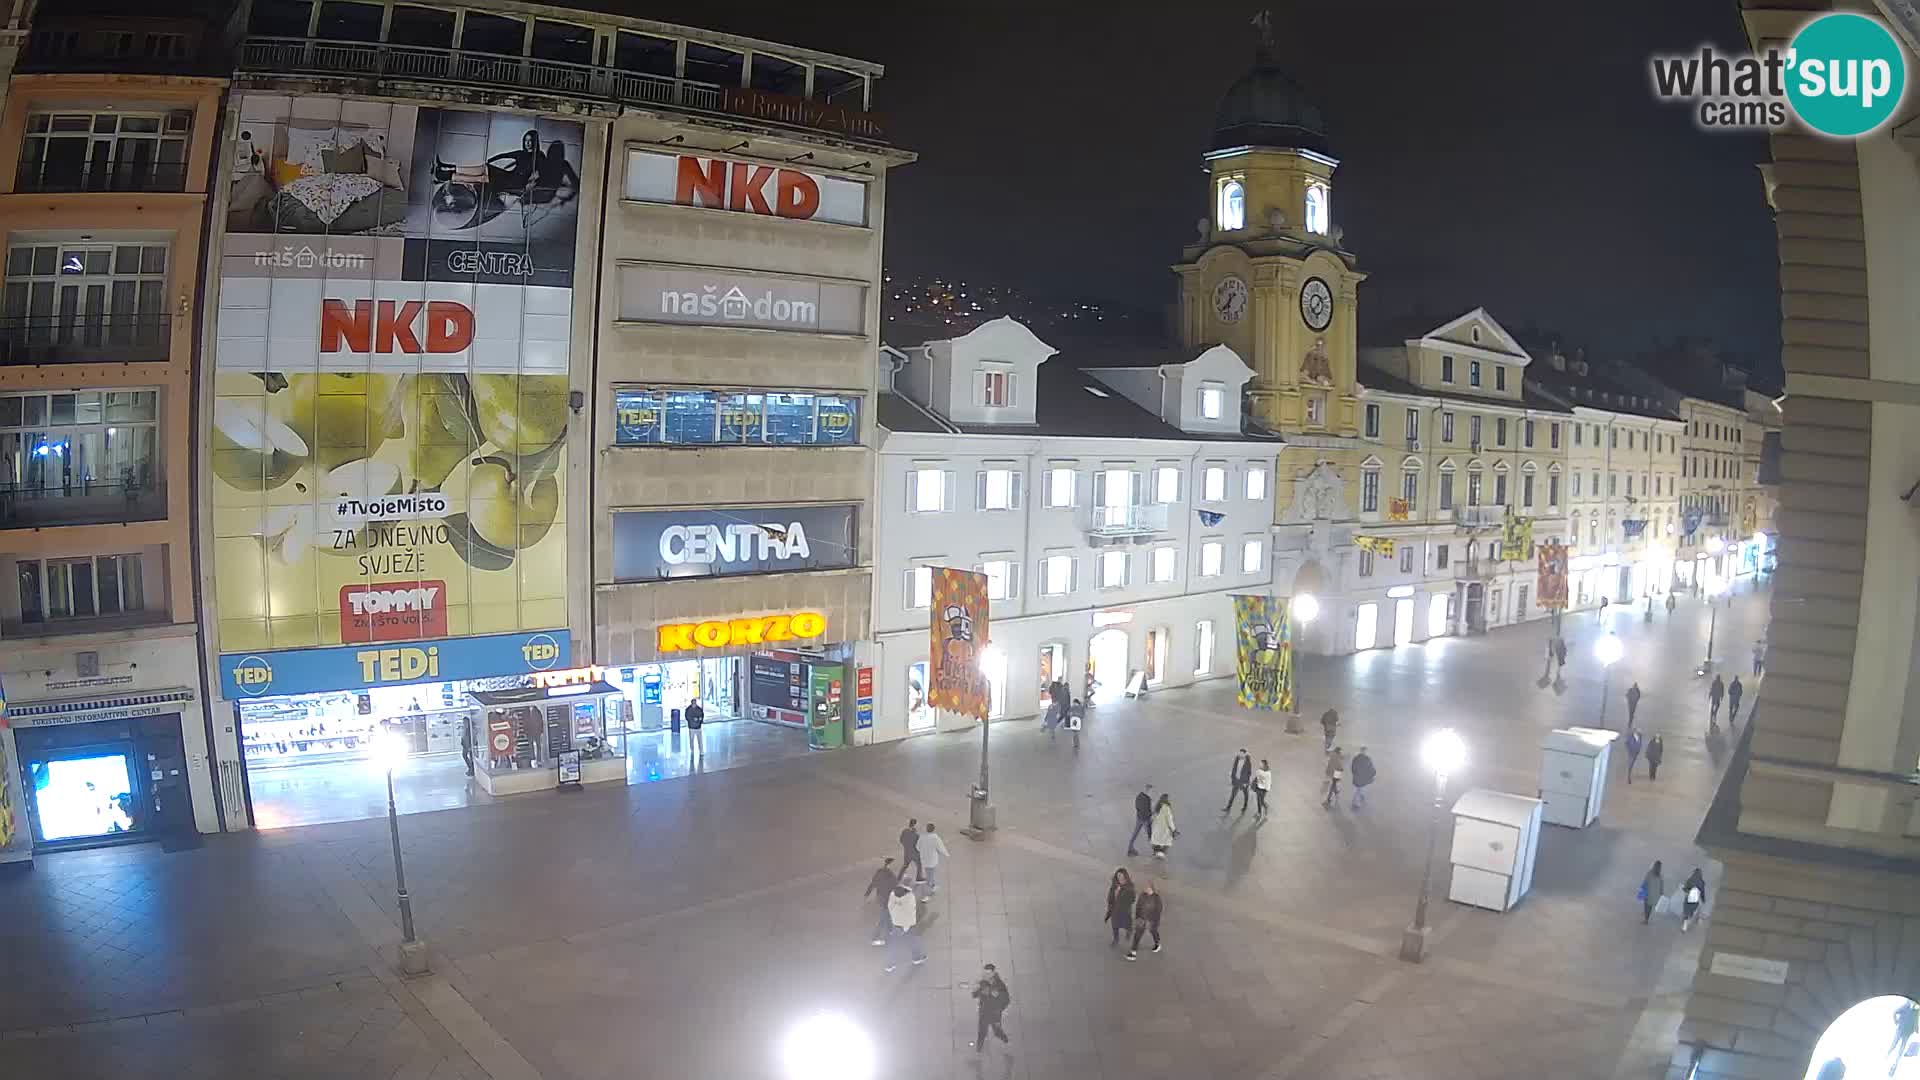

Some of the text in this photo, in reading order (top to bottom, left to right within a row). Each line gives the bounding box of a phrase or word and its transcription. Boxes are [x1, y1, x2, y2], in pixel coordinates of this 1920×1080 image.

[676, 154, 820, 219] NKD
[254, 245, 366, 270] naš dom
[447, 250, 535, 277] CENTRA
[661, 285, 817, 323] naš dom
[320, 297, 477, 354] NKD
[336, 497, 446, 518] #TvojeMisto
[333, 524, 450, 550] ZA DNEVNO
[659, 521, 810, 565] CENTRA
[358, 548, 425, 576] SVJEŽE
[348, 588, 439, 615] TOMMY
[657, 612, 826, 653] KORZO
[357, 646, 440, 684] TEDi
[522, 643, 560, 661] TEDi
[233, 667, 273, 687] TEDi
